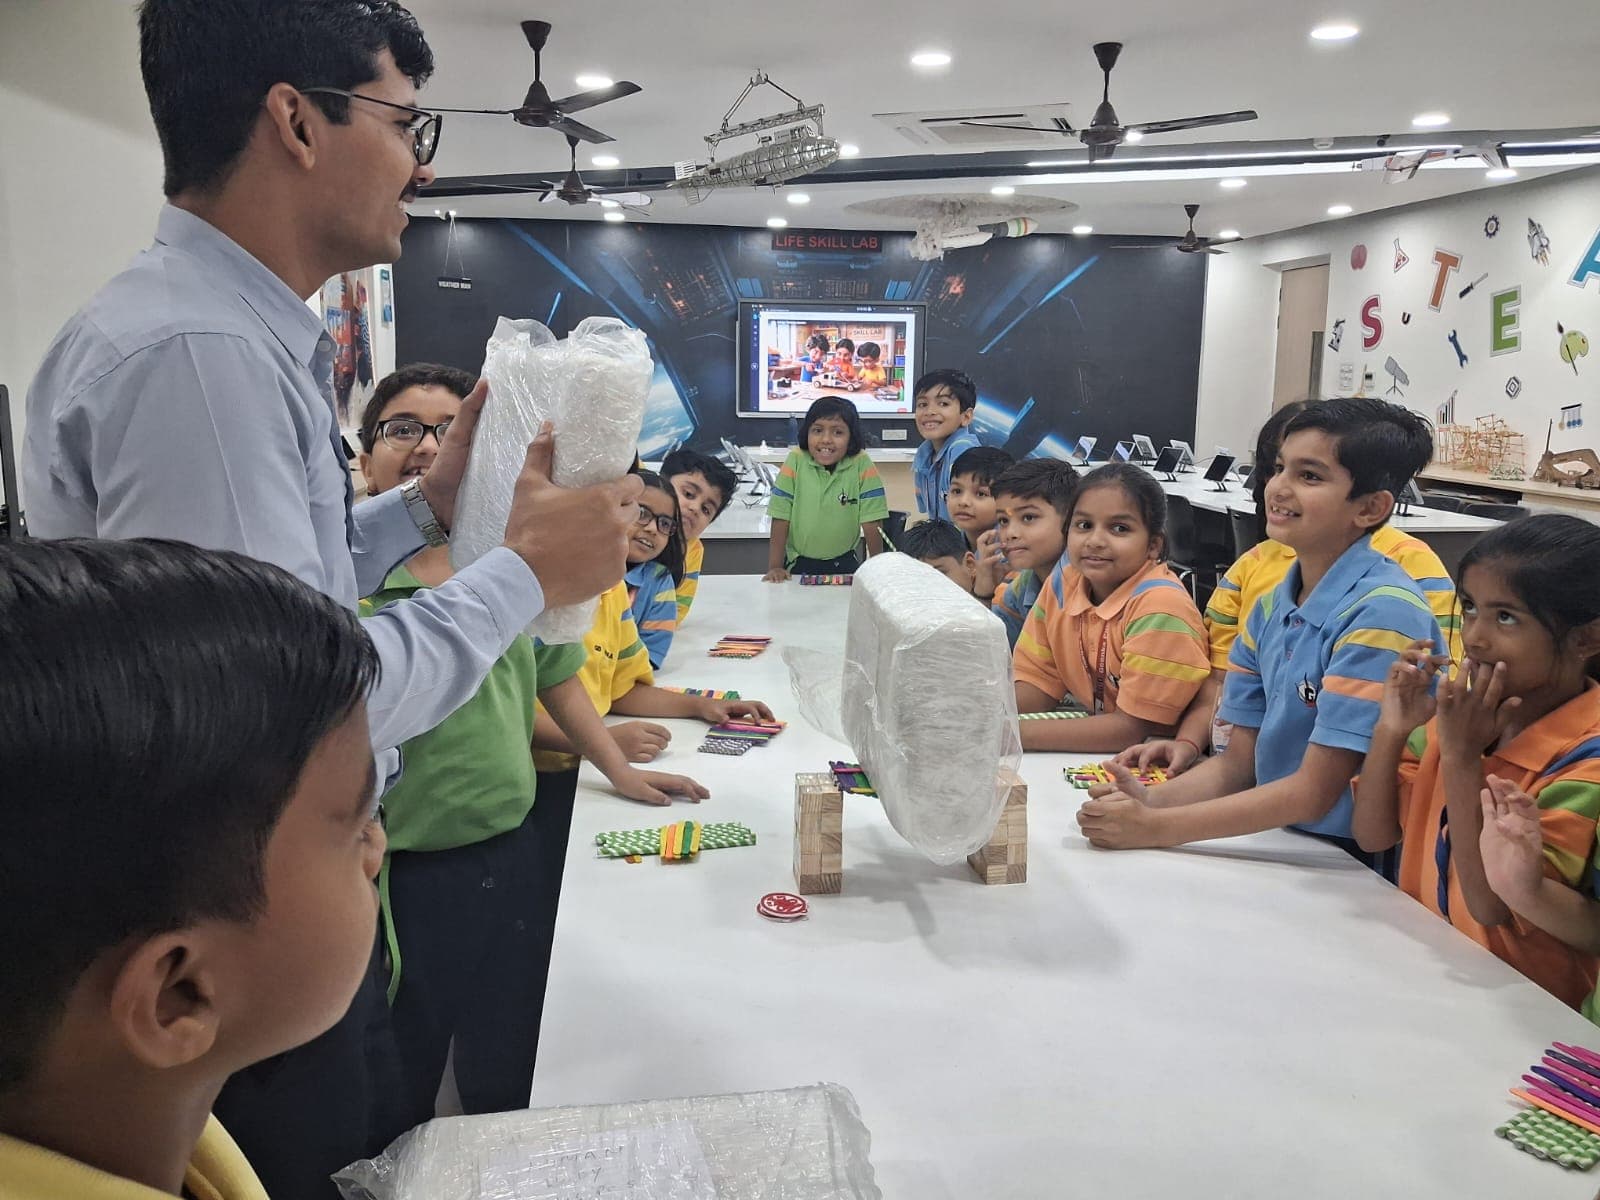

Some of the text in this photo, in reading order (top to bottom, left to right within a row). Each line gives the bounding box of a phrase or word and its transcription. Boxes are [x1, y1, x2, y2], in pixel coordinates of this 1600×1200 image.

[775, 235, 879, 249] LIFE SKILL LAB
[1361, 296, 1383, 349] S
[1430, 249, 1460, 309] T
[1491, 288, 1520, 353] E
